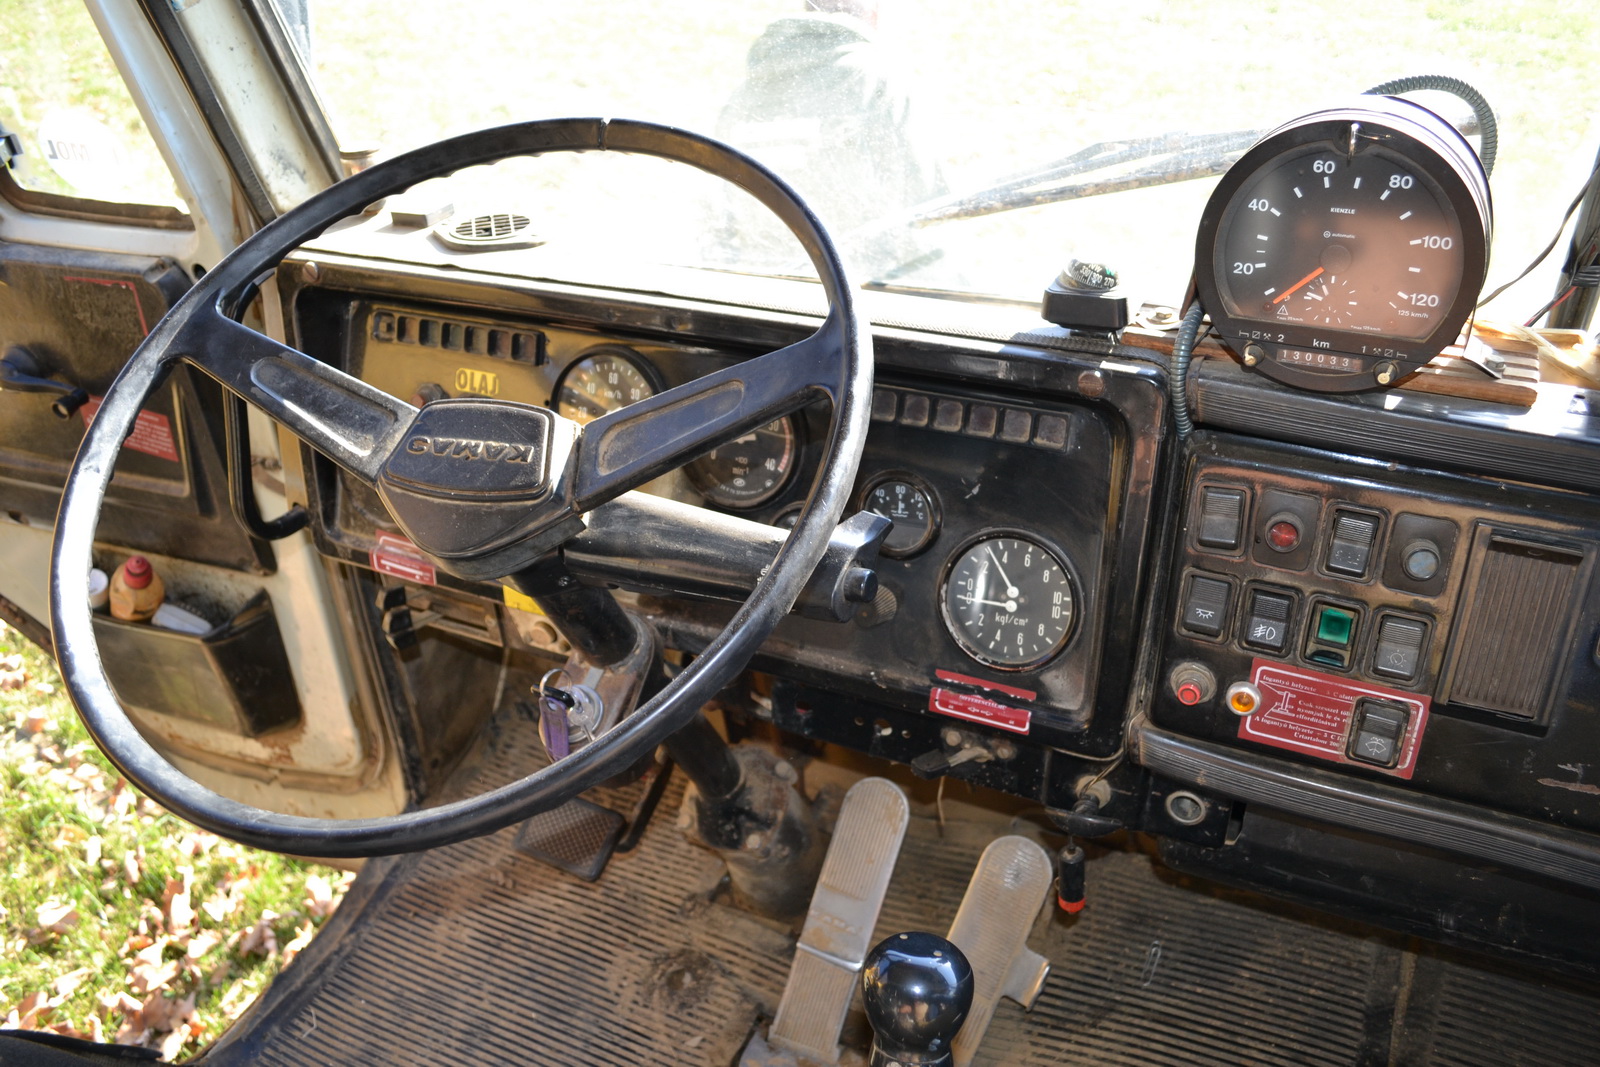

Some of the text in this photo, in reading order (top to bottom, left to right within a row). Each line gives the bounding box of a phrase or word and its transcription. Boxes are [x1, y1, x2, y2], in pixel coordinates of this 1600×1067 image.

[1312, 160, 1335, 174] 60
[1389, 175, 1413, 190] 80
[1248, 199, 1269, 212] 40
[1422, 235, 1452, 250] 100
[1233, 262, 1254, 275] 20
[1104, 276, 1115, 287] 270
[1410, 294, 1439, 308] 120
[1398, 309, 1429, 319] 125 km/h
[1277, 334, 1285, 342] 2
[1312, 338, 1330, 349] km
[1361, 345, 1367, 354] 1
[456, 369, 499, 396] OLAJ
[586, 382, 596, 394] 40
[603, 389, 622, 400] km/h
[764, 458, 776, 471] 40
[875, 489, 885, 497] 40
[895, 485, 906, 494] 80
[1002, 551, 1008, 564] 4
[1024, 554, 1031, 567] 6
[982, 561, 989, 574] 2
[1043, 570, 1050, 583] 8
[967, 578, 974, 591] 0
[1053, 591, 1062, 604] 10
[1052, 606, 1061, 619] 10
[978, 614, 985, 626] 2
[995, 629, 1001, 642] 4
[1038, 623, 1045, 637] 8
[1017, 632, 1023, 646] 6
